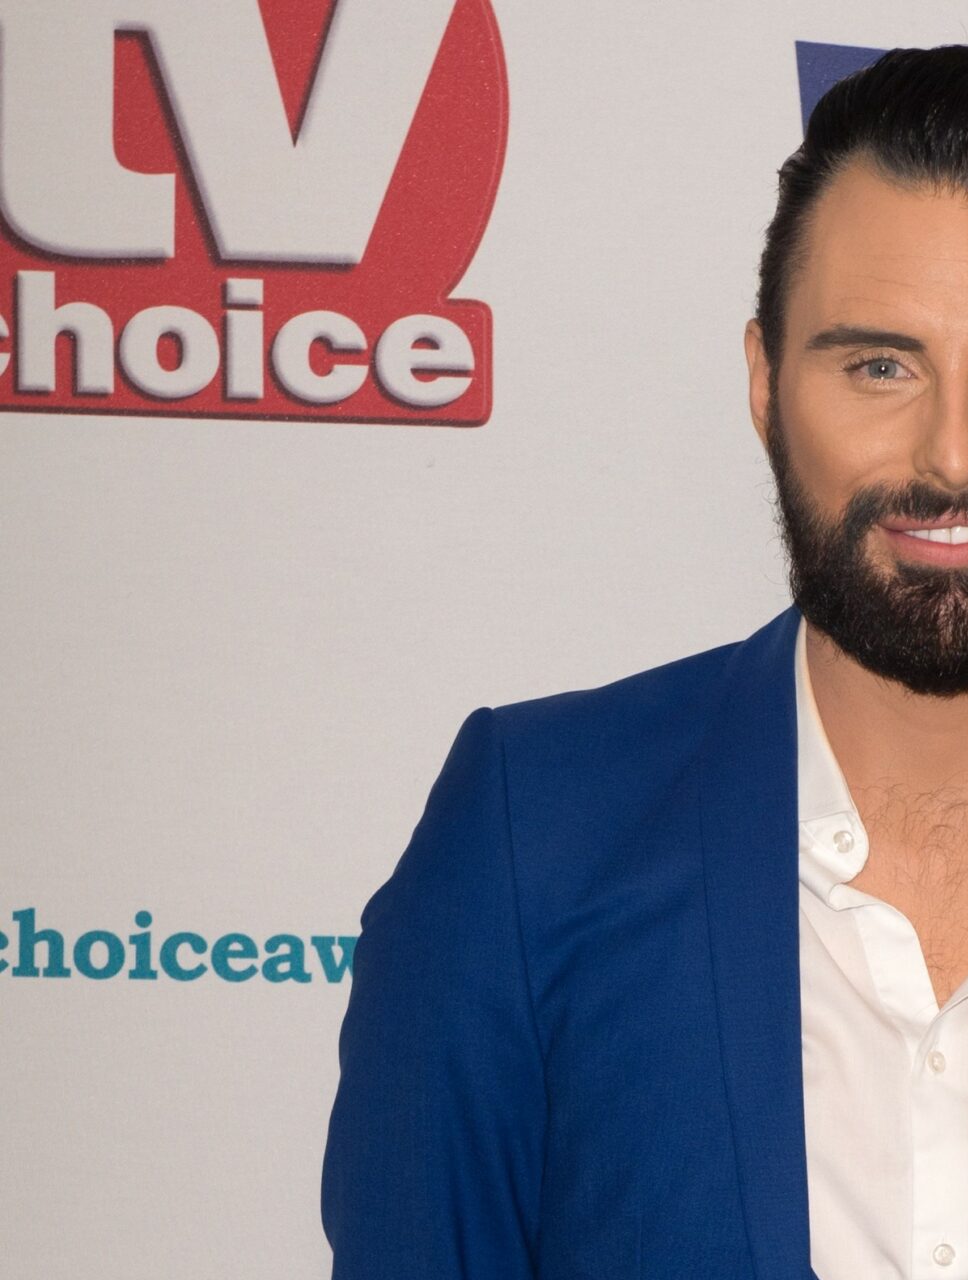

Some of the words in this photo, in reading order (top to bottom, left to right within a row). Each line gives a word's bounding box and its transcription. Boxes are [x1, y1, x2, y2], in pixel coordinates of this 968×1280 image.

[0, 0, 457, 263] tv
[0, 270, 475, 406] hoice
[0, 907, 359, 984] hoiceaw
